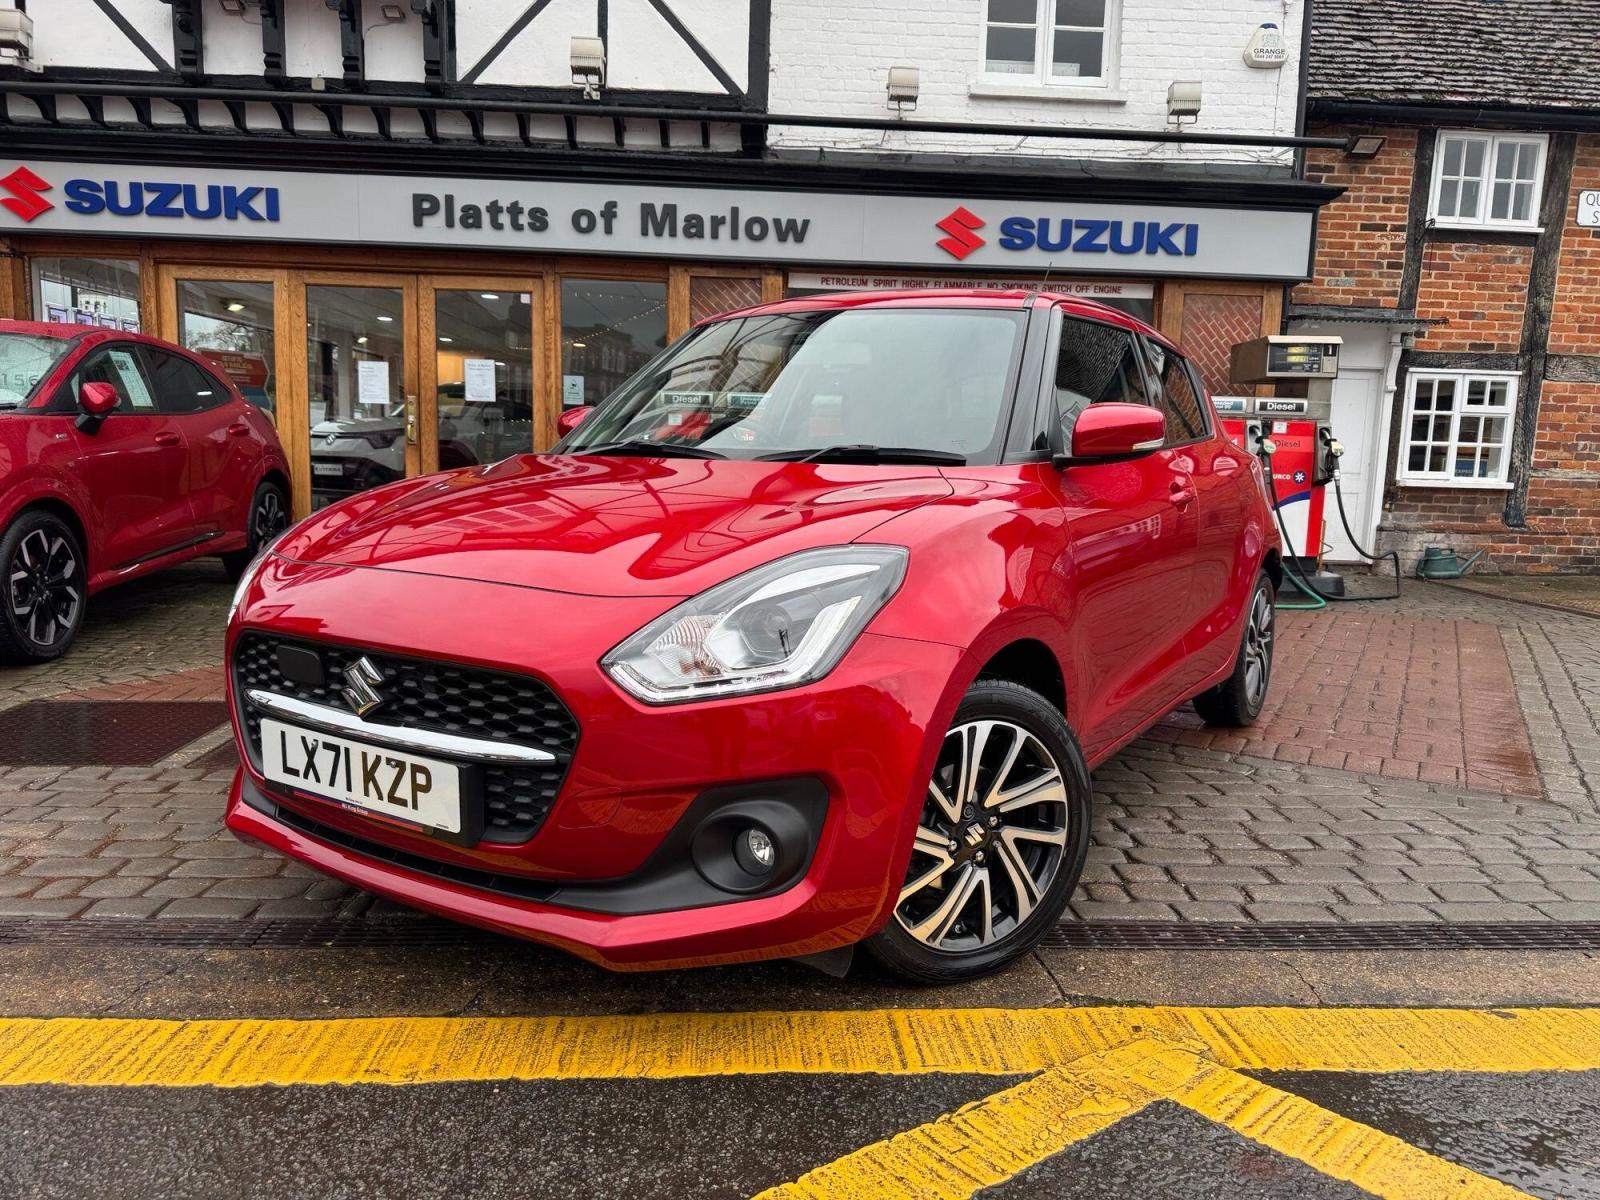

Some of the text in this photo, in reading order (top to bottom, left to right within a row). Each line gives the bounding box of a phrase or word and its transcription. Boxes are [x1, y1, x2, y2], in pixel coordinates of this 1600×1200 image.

[64, 179, 280, 222] SUZUKI
[412, 192, 811, 243] Platts of Marlow
[999, 216, 1199, 257] SUZUKI
[821, 277, 869, 287] PETROLEUM
[873, 278, 897, 288] SPIRIT
[902, 279, 929, 288] HIGHLY
[934, 281, 982, 289] FLAMMABLE
[1002, 282, 1037, 291] SMOKING
[1042, 283, 1071, 293] SWITCH
[1076, 285, 1090, 293] OFF
[1094, 285, 1122, 294] ENGINE
[1328, 344, 1333, 355] 1
[1267, 402, 1297, 411] Diesel
[1274, 439, 1301, 448] Diesel
[280, 731, 432, 810] LX71 KZP
